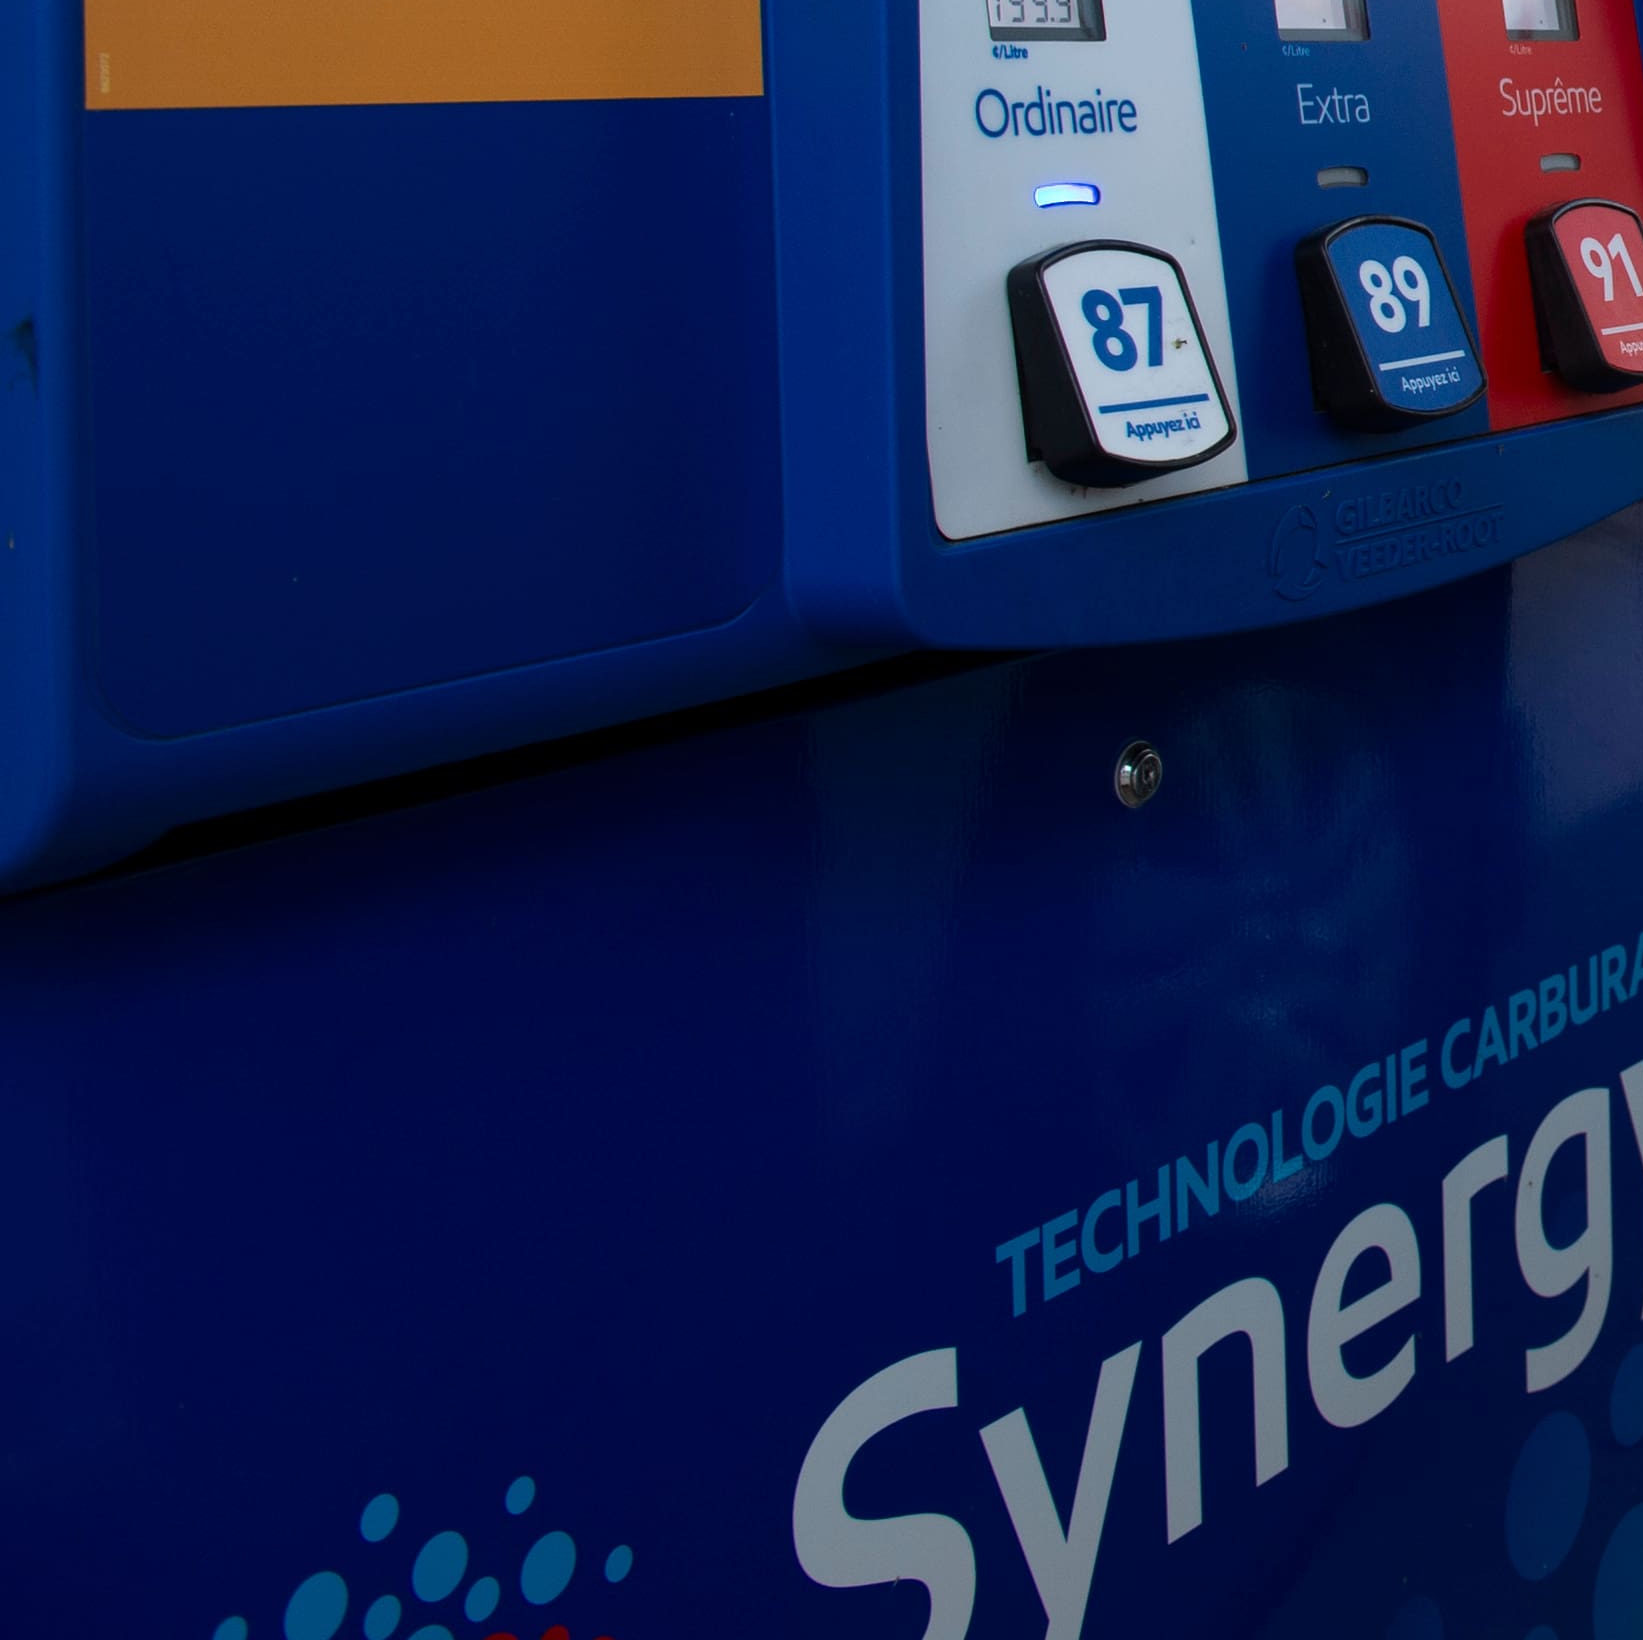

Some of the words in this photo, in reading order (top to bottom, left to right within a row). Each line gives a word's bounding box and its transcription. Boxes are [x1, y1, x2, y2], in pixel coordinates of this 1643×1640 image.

[974, 85, 1139, 140] Ordinaire
[1297, 82, 1372, 126] Extra
[1499, 76, 1604, 129] Suprême
[1358, 255, 1433, 335] 89
[1080, 285, 1165, 373] 87
[1401, 371, 1447, 396] Appuyez
[1447, 368, 1461, 388] ici
[1125, 414, 1186, 444] Appuyez
[1185, 411, 1202, 436] ici
[1335, 472, 1465, 536] GILBARCO
[1335, 512, 1505, 582] VEEDER-ROOT
[994, 1037, 1429, 1318] TECHNOLOGIE
